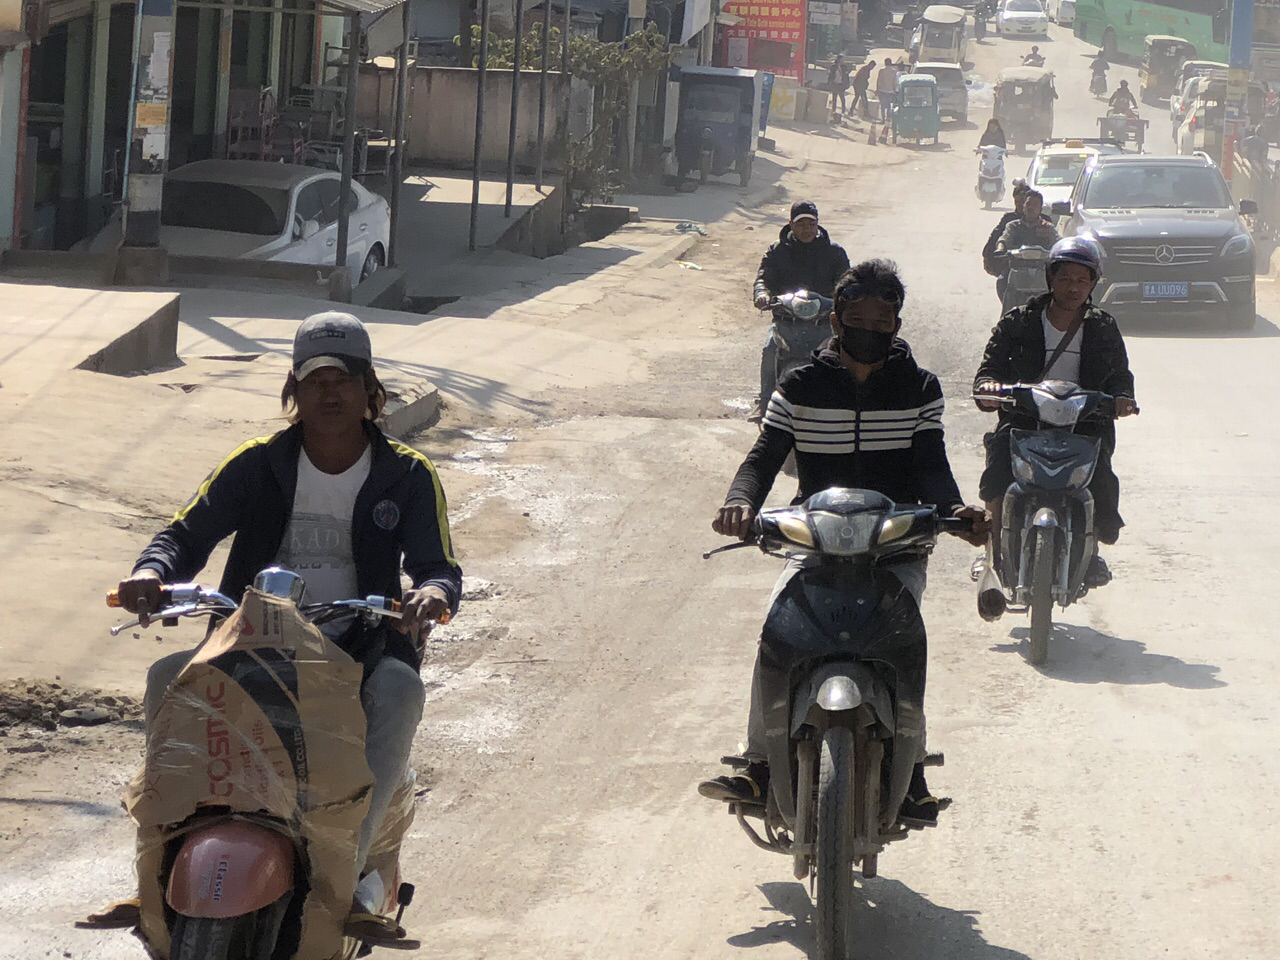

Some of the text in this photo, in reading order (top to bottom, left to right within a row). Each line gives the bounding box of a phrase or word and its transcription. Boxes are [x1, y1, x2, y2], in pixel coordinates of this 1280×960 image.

[729, 5, 801, 17] 互联网服务中心
